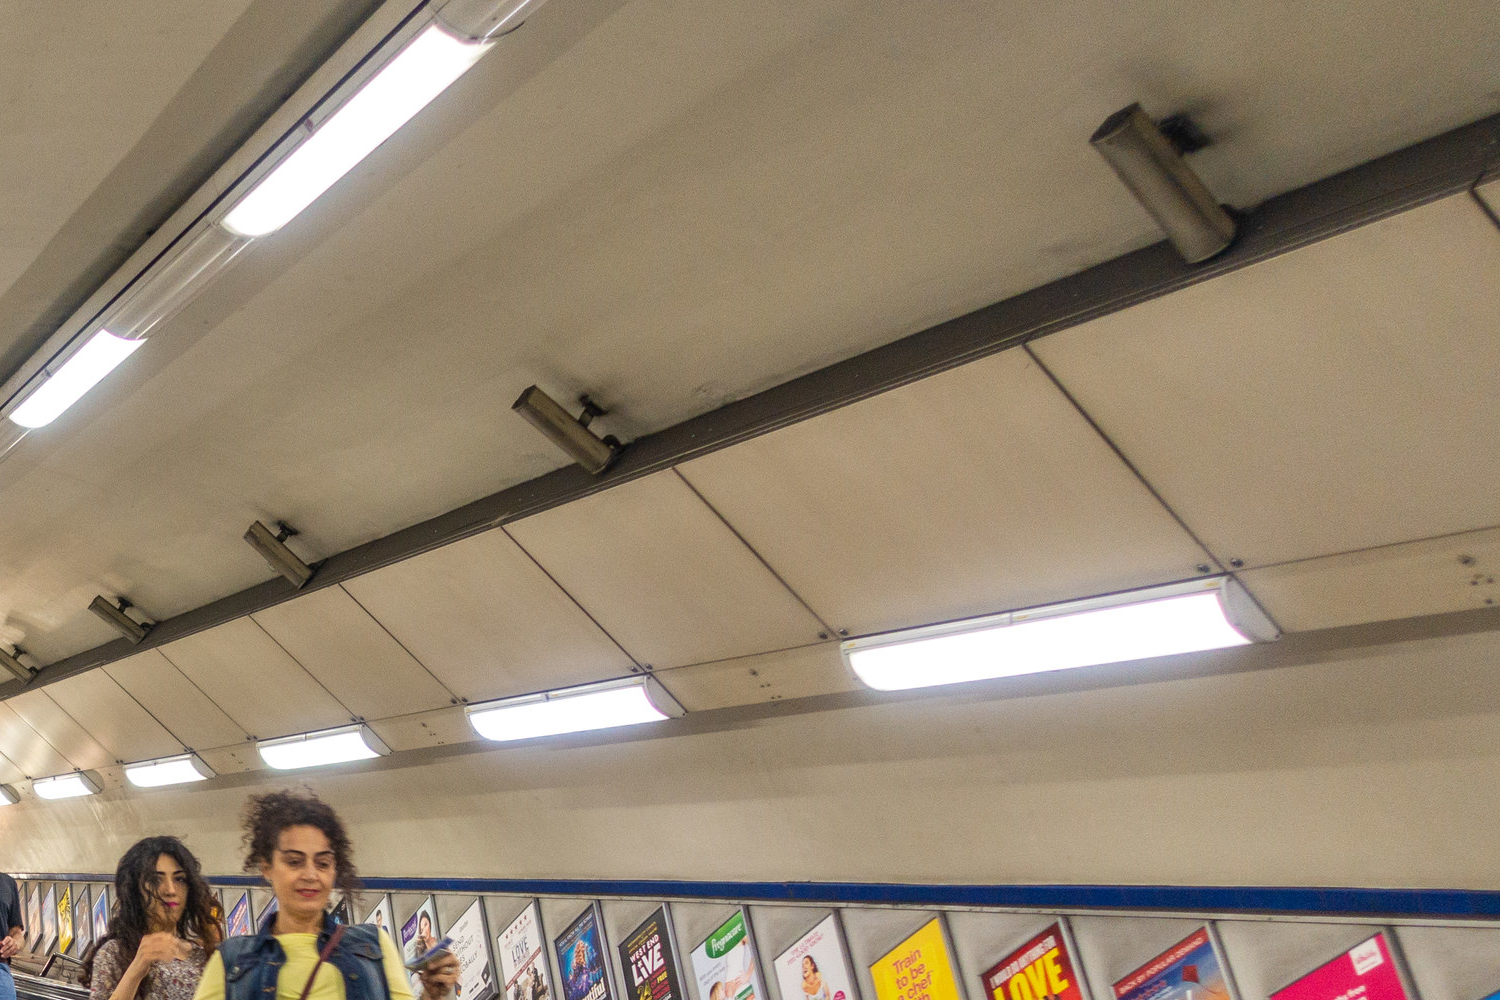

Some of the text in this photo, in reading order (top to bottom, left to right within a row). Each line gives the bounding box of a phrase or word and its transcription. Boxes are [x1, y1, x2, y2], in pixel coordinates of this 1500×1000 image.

[452, 935, 465, 952] SEND
[511, 936, 529, 962] LOVE
[629, 944, 646, 963] WEST
[647, 934, 660, 949] END
[711, 922, 742, 957] Pregnacare
[892, 949, 921, 974] Train
[1119, 936, 1204, 994] BACK BY POPULAR DEMAND
[657, 971, 668, 984] FREE
[895, 963, 925, 990] to be
[907, 972, 932, 999] chef
[1347, 985, 1366, 997] free
